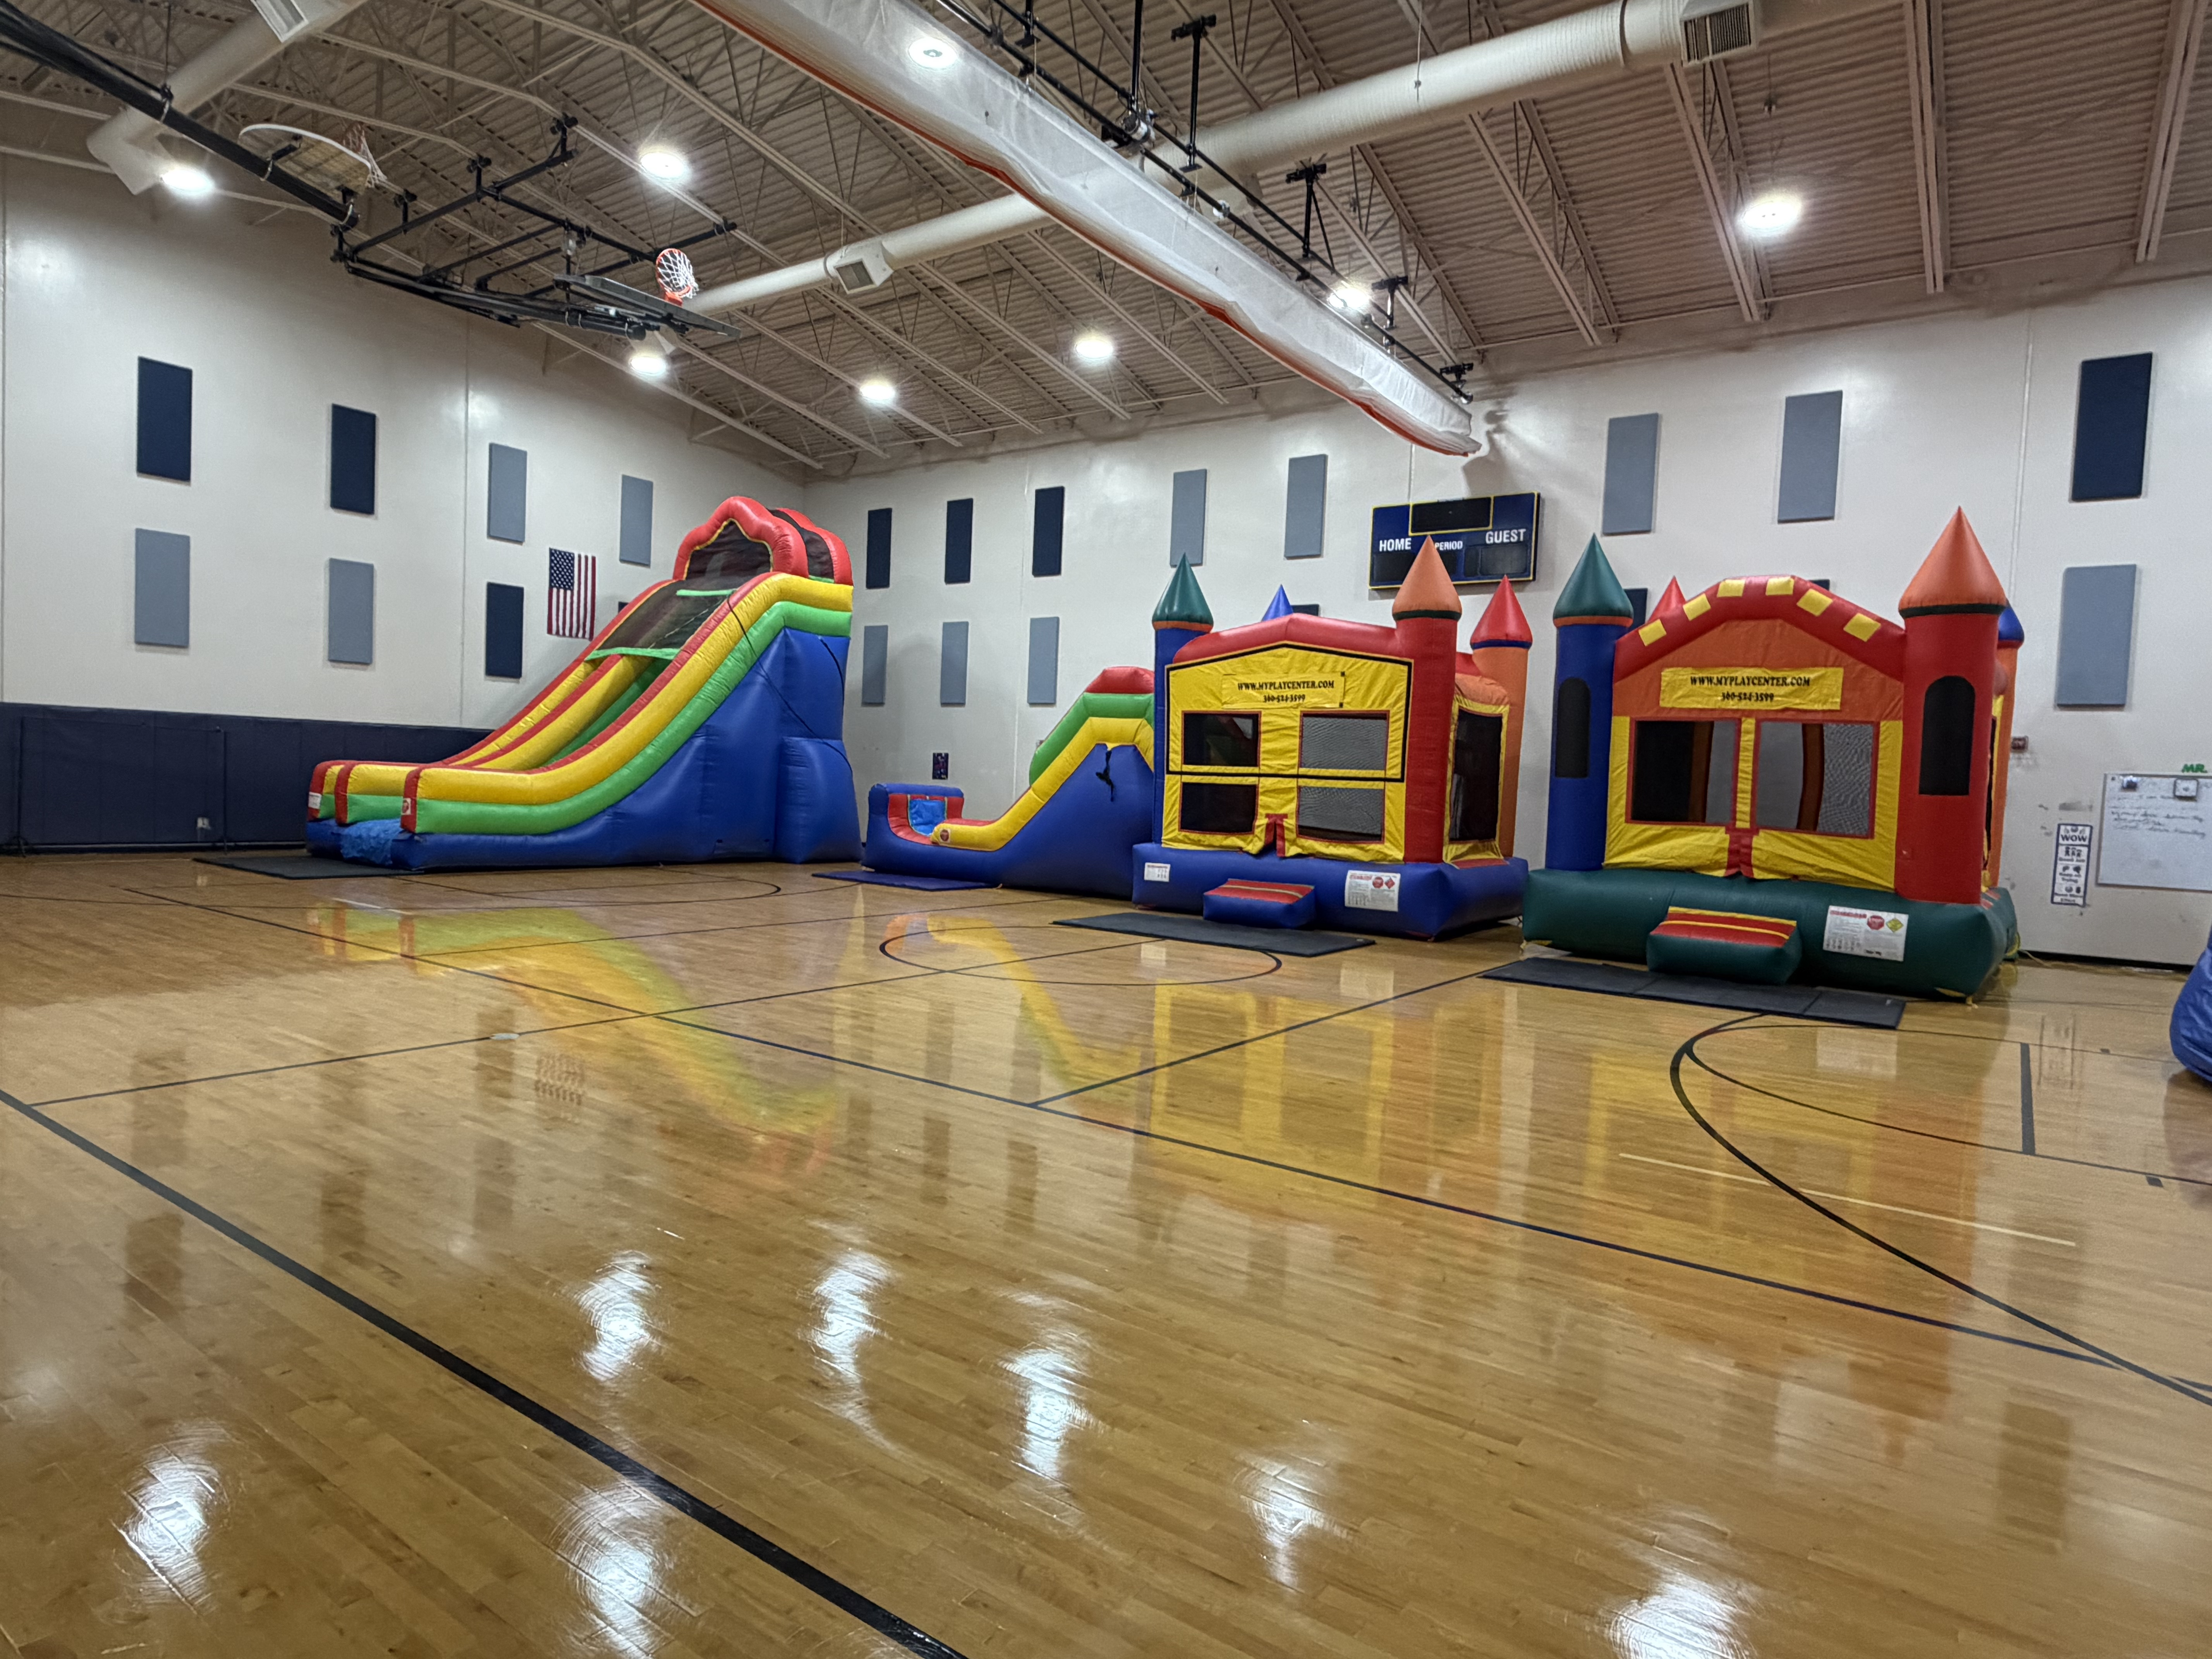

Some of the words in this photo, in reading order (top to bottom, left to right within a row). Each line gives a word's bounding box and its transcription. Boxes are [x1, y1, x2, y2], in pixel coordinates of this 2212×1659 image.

[1486, 529, 1527, 544] GUEST
[1379, 538, 1412, 552] HOME
[1434, 541, 1463, 551] PERIOD
[1237, 680, 1334, 690] WWW.MYPLAYCENTER.COM
[1690, 675, 1810, 687] WWW.MYPLAYCENTER.COM
